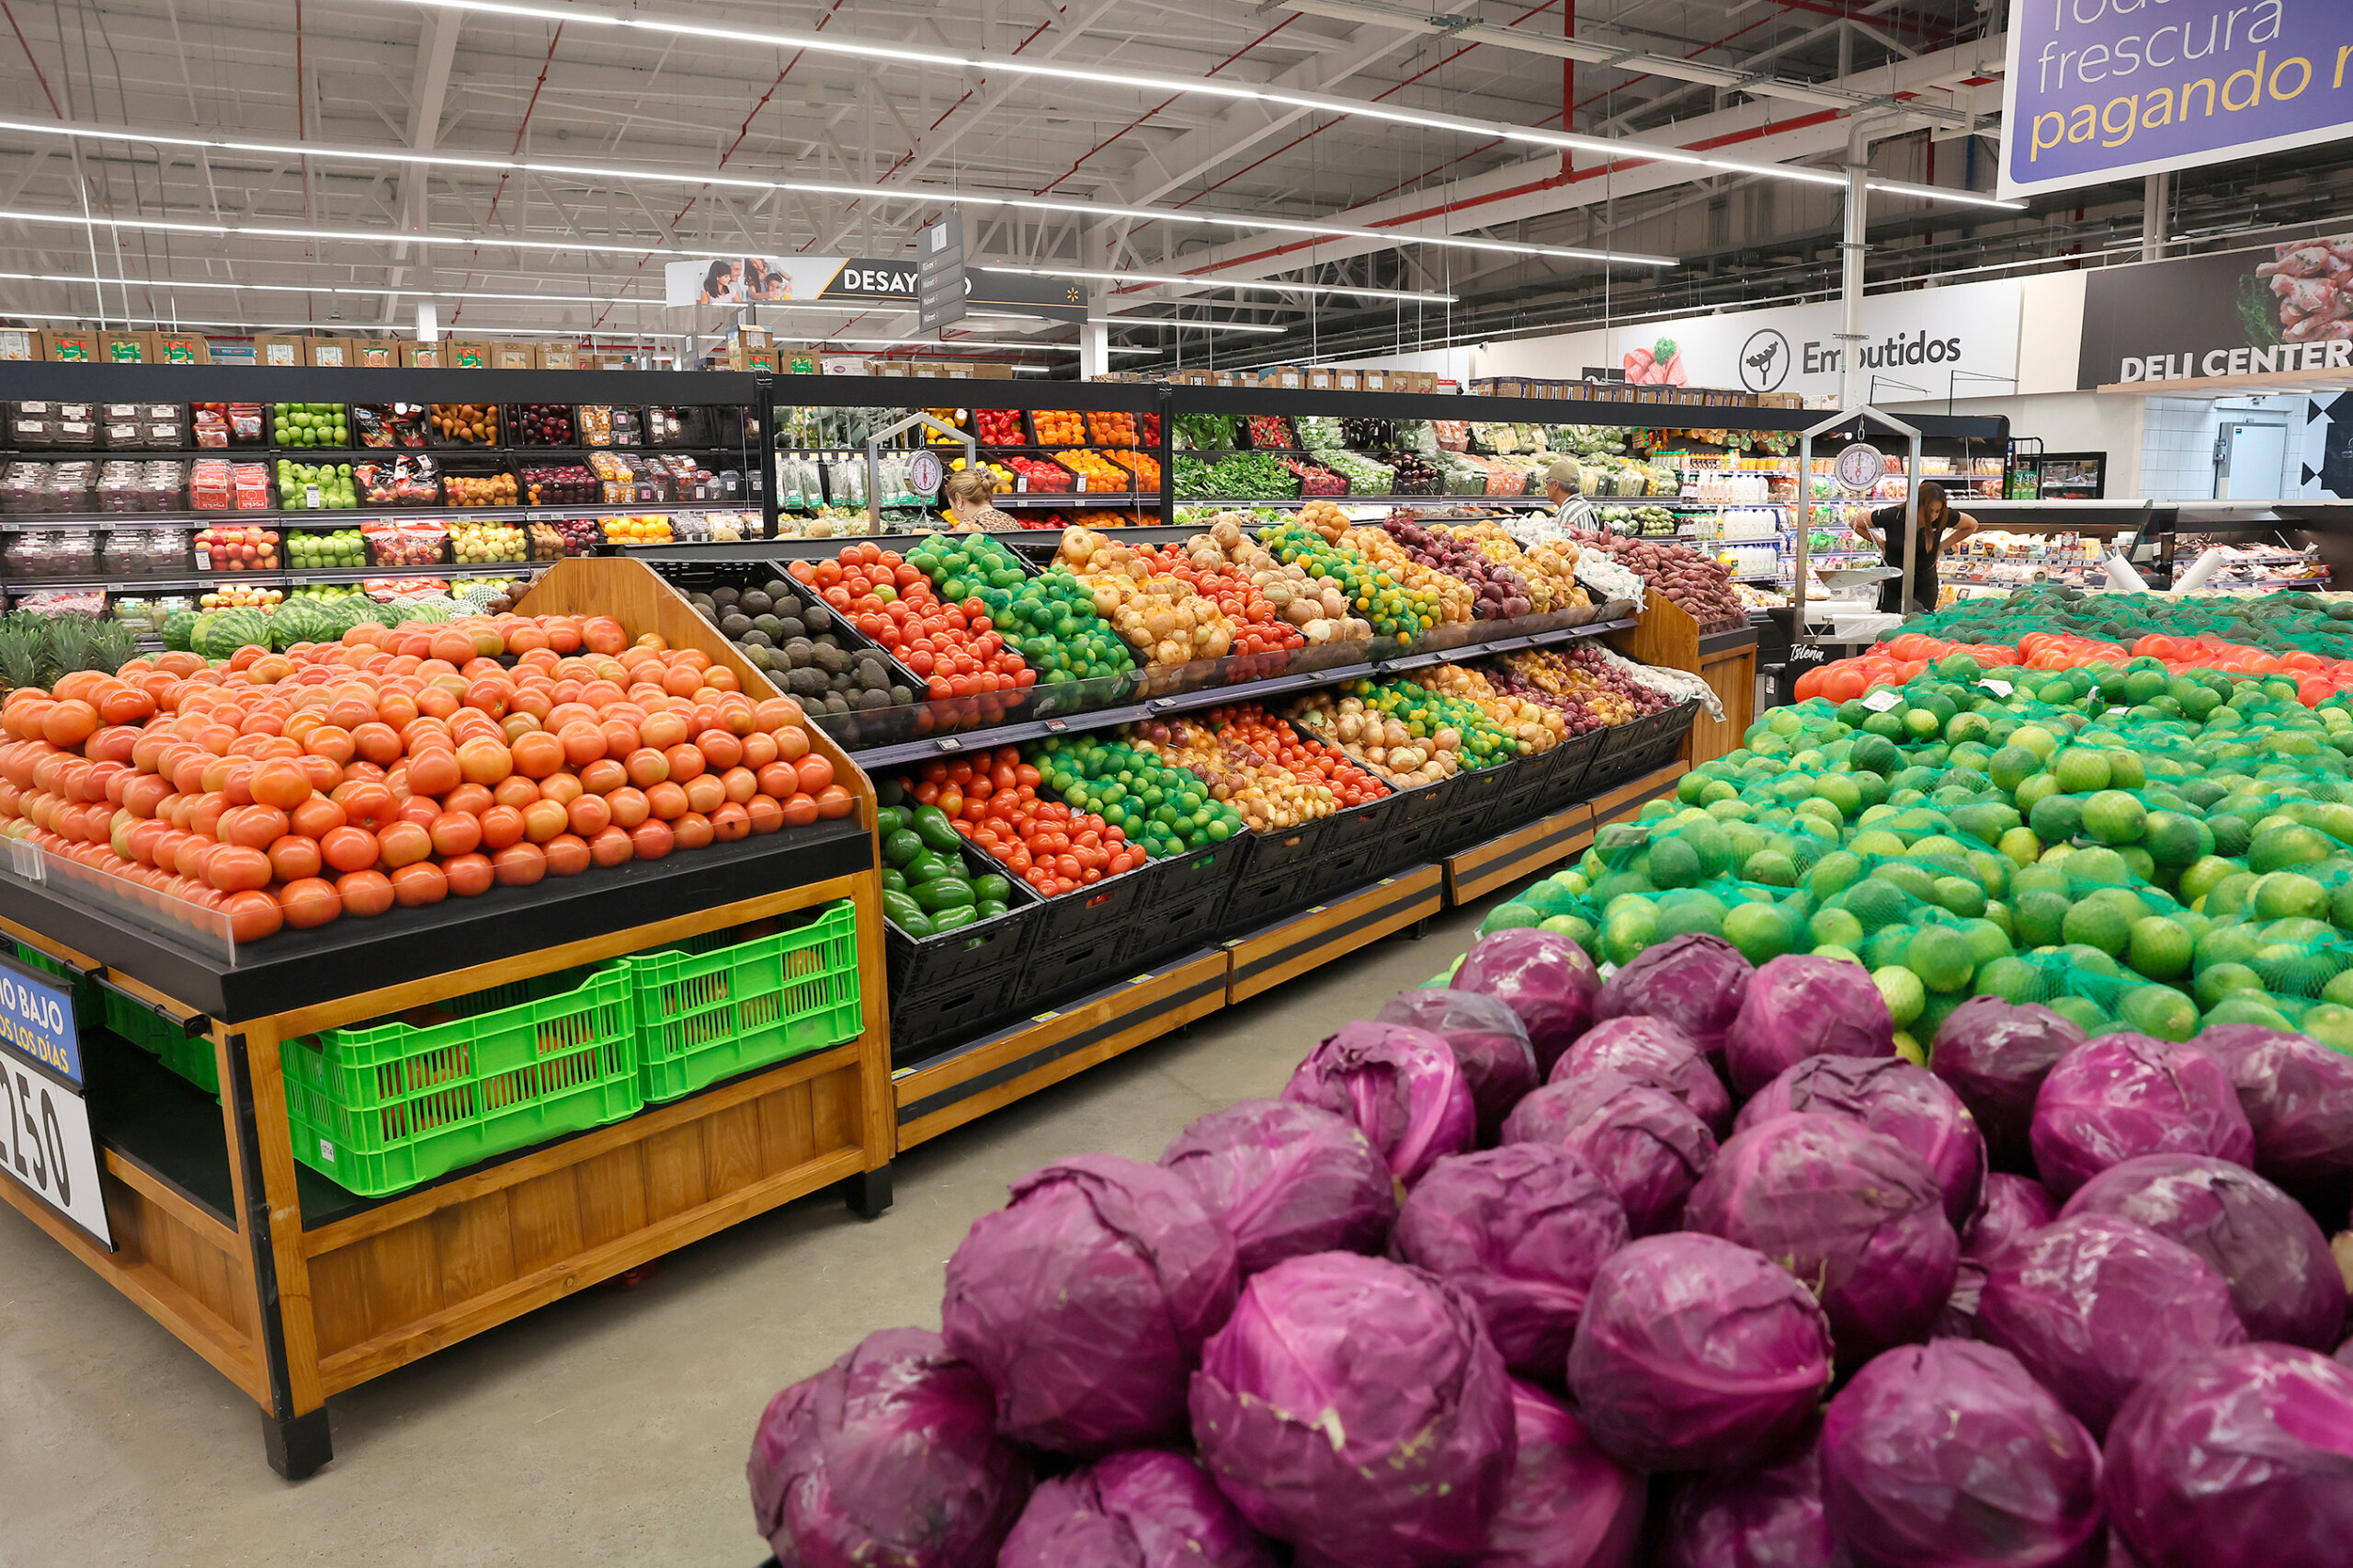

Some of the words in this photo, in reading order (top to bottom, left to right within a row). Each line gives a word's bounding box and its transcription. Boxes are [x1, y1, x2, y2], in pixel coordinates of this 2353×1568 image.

[2054, 0, 2171, 31] To
[2038, 0, 2284, 93] frescura
[2029, 50, 2313, 162] pagando
[844, 268, 972, 296] DESAY
[1803, 330, 1961, 374] Emutidos
[2120, 352, 2194, 383] DELI
[2202, 338, 2353, 377] CENTER
[17, 984, 63, 1035] BAJO
[13, 1022, 37, 1056] LOS
[37, 1033, 69, 1074] DÍAS
